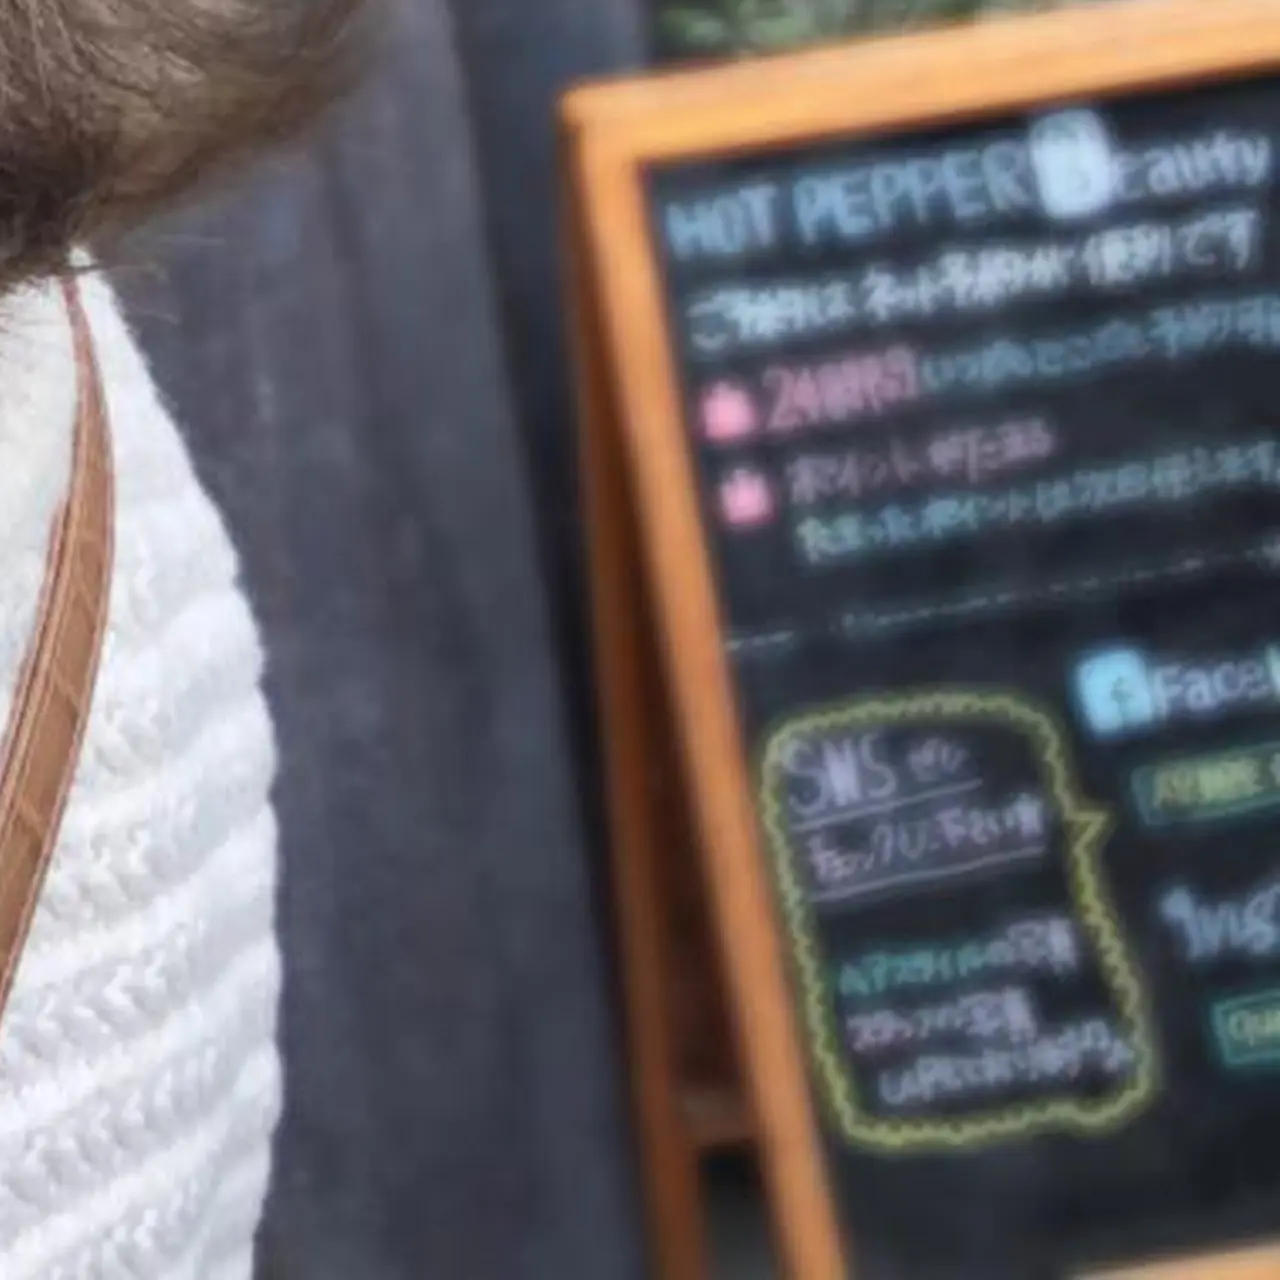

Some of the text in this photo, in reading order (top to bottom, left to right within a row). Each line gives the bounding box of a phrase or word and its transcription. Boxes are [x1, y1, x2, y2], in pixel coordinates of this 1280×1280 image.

[666, 184, 776, 260] HOT
[792, 142, 1031, 244] PEPPER
[781, 732, 898, 816] SNS
